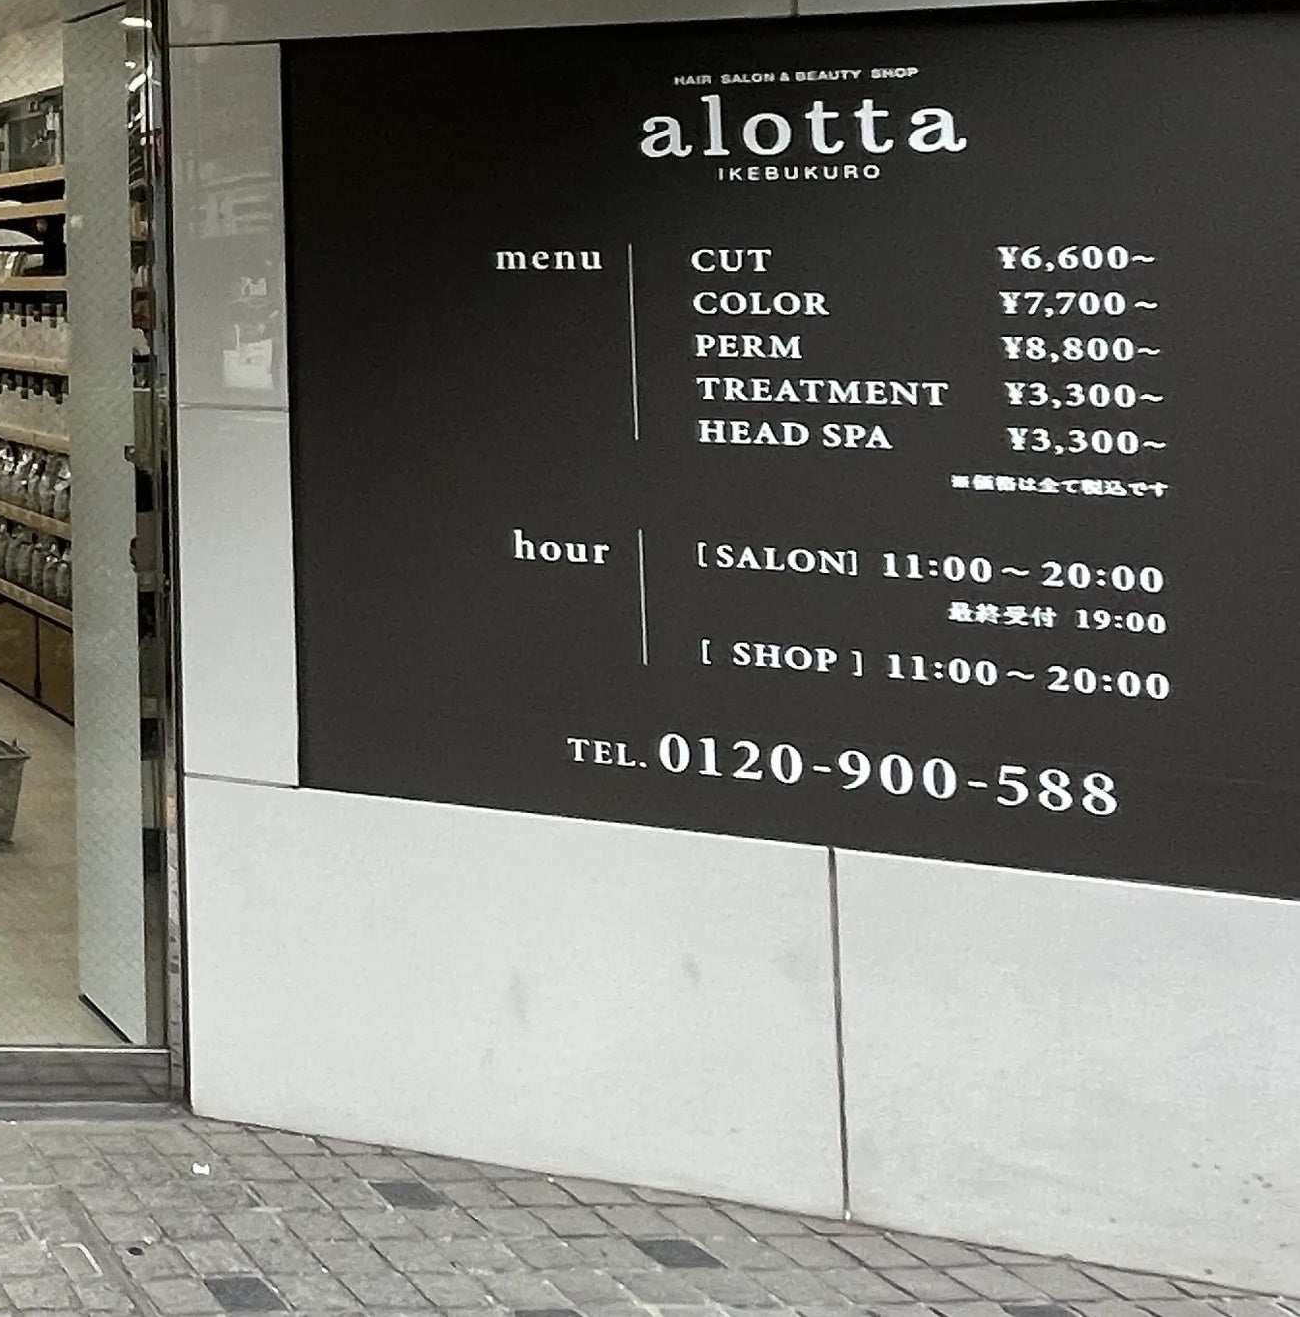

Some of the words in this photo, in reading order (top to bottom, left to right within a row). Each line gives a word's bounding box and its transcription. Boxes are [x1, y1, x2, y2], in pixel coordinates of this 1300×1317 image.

[673, 73, 712, 86] HAIR
[720, 72, 775, 85] SALON
[779, 70, 791, 83] &
[795, 68, 863, 82] BEAUTY
[870, 66, 920, 80] SHOP
[640, 94, 968, 158] alotta
[717, 164, 881, 181] IKEBUKURO
[495, 249, 604, 271] menu
[690, 248, 773, 273] CUT
[691, 290, 831, 317] COLOR
[694, 333, 804, 360] PERM
[694, 377, 950, 407] TREATMENT
[697, 419, 811, 446] HEAD
[822, 423, 895, 450] SPA
[512, 529, 611, 565] hour
[948, 601, 1059, 629] 最終受付
[1076, 609, 1167, 635] 19:00
[565, 736, 649, 769] TEL.
[658, 732, 1119, 817] 0120-900-588
